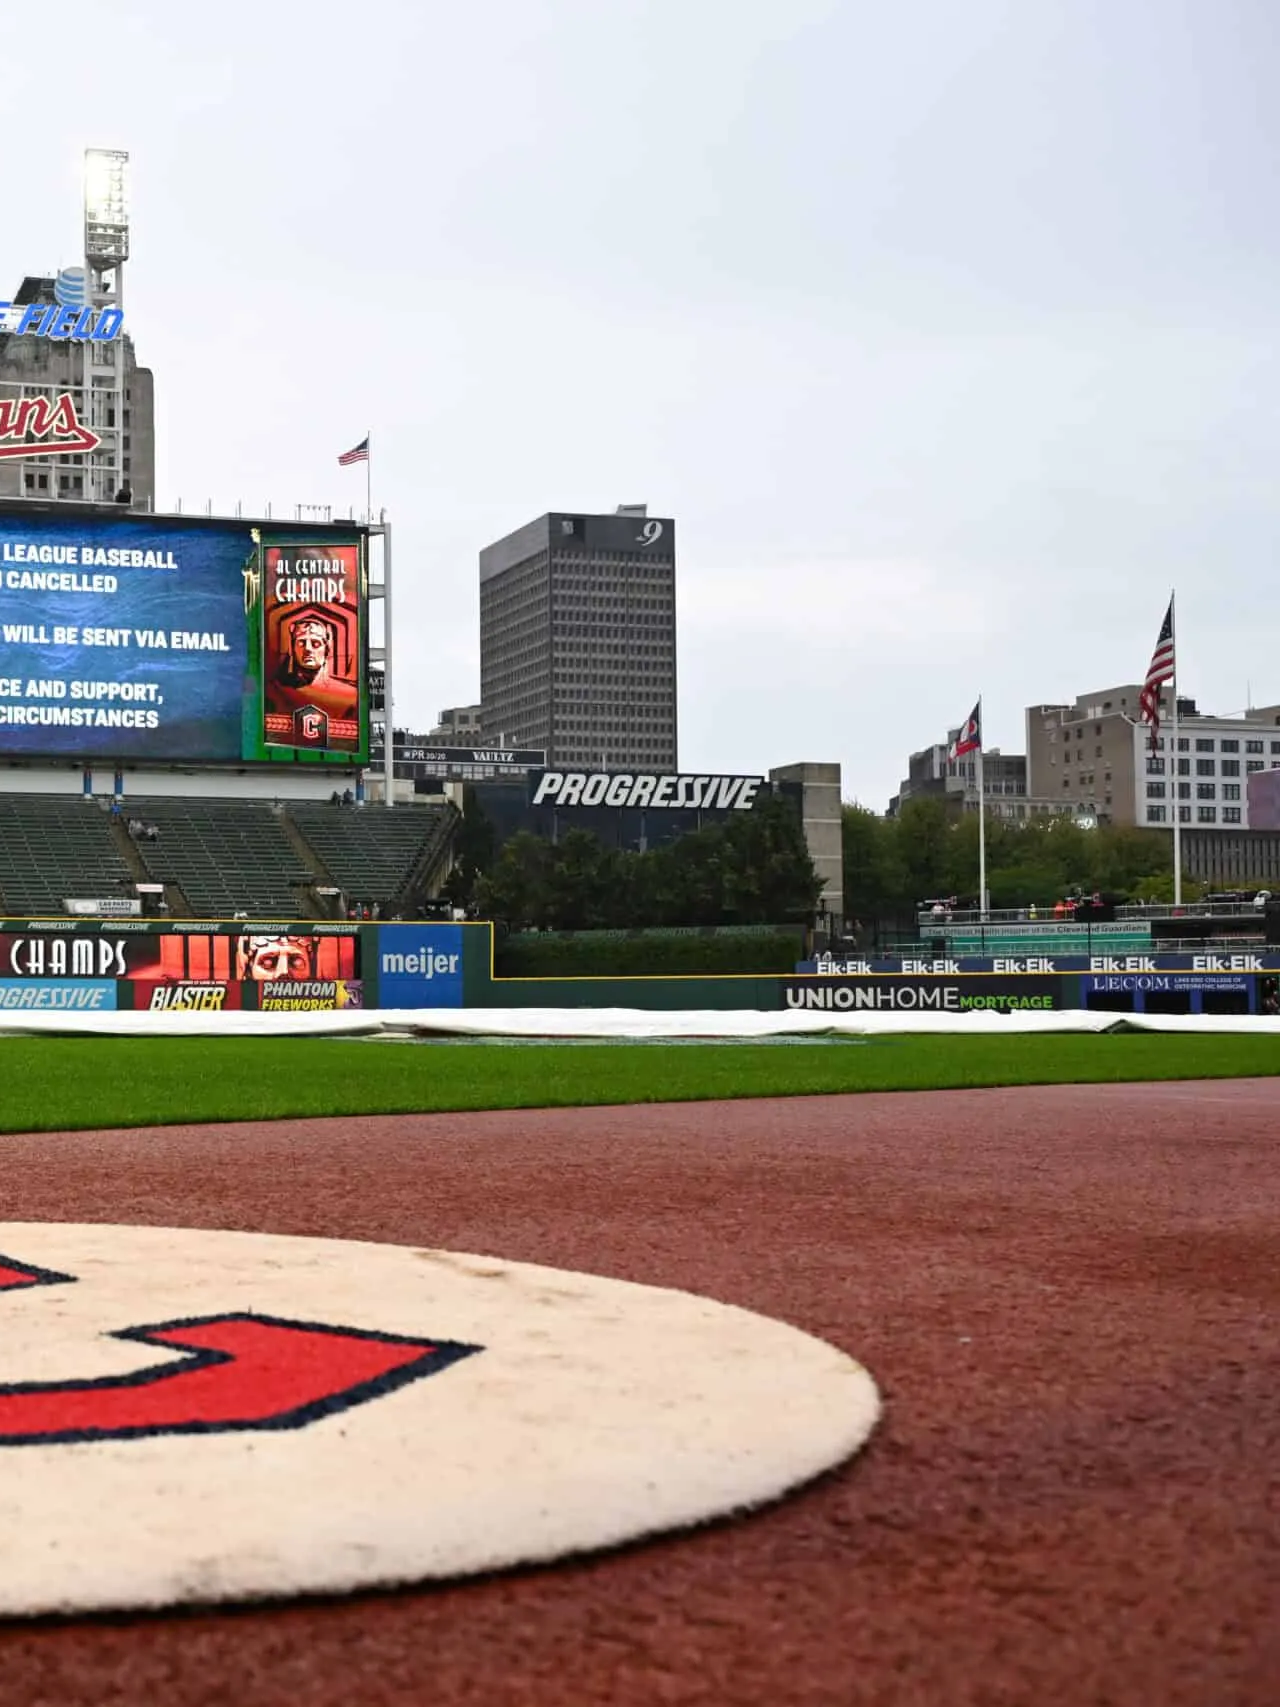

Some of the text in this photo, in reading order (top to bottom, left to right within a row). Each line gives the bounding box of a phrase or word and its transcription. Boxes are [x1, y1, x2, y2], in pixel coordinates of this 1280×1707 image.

[16, 303, 125, 341] FIELD
[4, 544, 78, 564] LEAGUE
[82, 547, 178, 569] BASEBALL
[276, 559, 347, 575] AL CENTRAL
[7, 571, 118, 593] CANCELLED
[276, 578, 345, 603] CHAMPS
[3, 625, 50, 644] WILL
[54, 627, 78, 645] BE
[82, 628, 132, 647] SENT
[135, 630, 167, 648] VIA
[171, 632, 230, 651] EMAIL
[26, 680, 66, 698] AND
[70, 681, 163, 704] SUPPORT,
[532, 772, 765, 809] PROGRESSIVE
[10, 939, 127, 976] CHAMPS
[383, 947, 459, 980] meijer
[150, 986, 225, 1010] BLASTER
[263, 982, 336, 997] PHANTOM
[262, 999, 334, 1010] FIREWORKS
[960, 996, 1053, 1009] MORTGAGE
